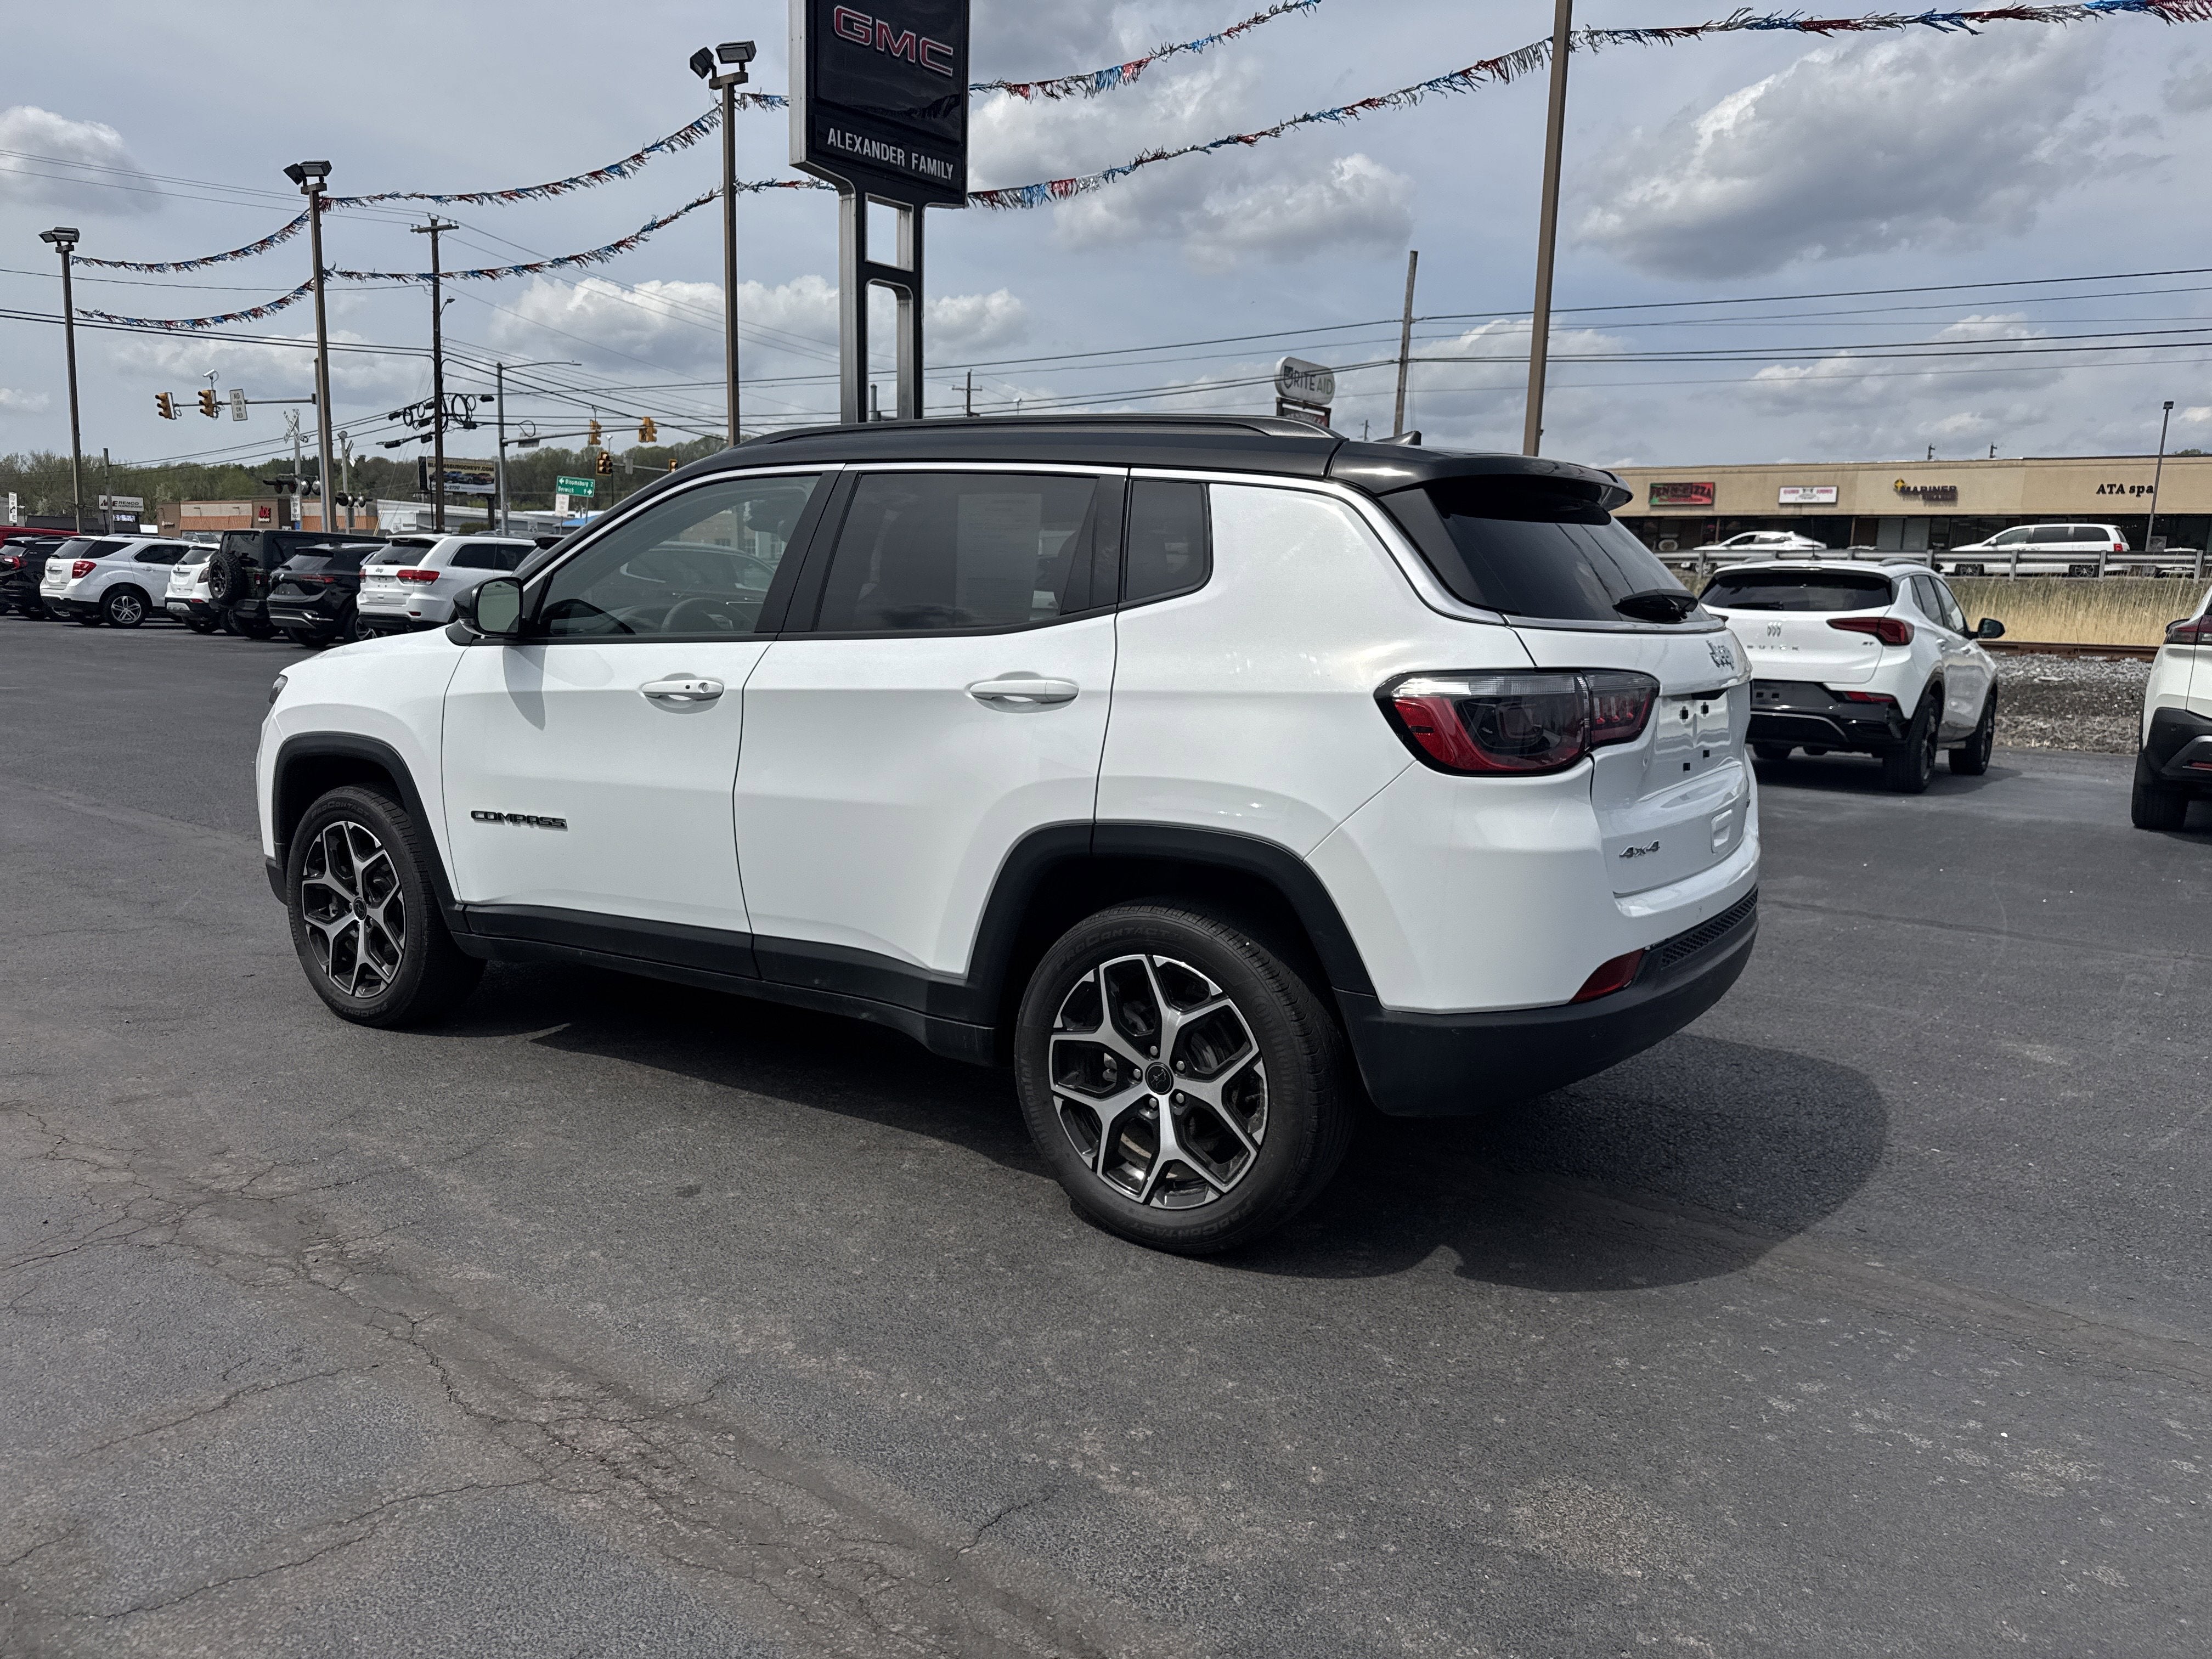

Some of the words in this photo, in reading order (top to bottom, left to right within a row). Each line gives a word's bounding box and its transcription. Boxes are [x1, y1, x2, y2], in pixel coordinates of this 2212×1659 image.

[834, 5, 953, 77] GMC
[827, 127, 905, 167] ALEXANDER
[911, 153, 953, 180] FAMILY
[1294, 370, 1315, 391] RITE
[1317, 377, 1333, 394] AID
[2096, 483, 2125, 494] ATA
[2129, 485, 2154, 498] spa
[471, 810, 567, 827] COMPASS
[1619, 839, 1660, 858] 4x4
